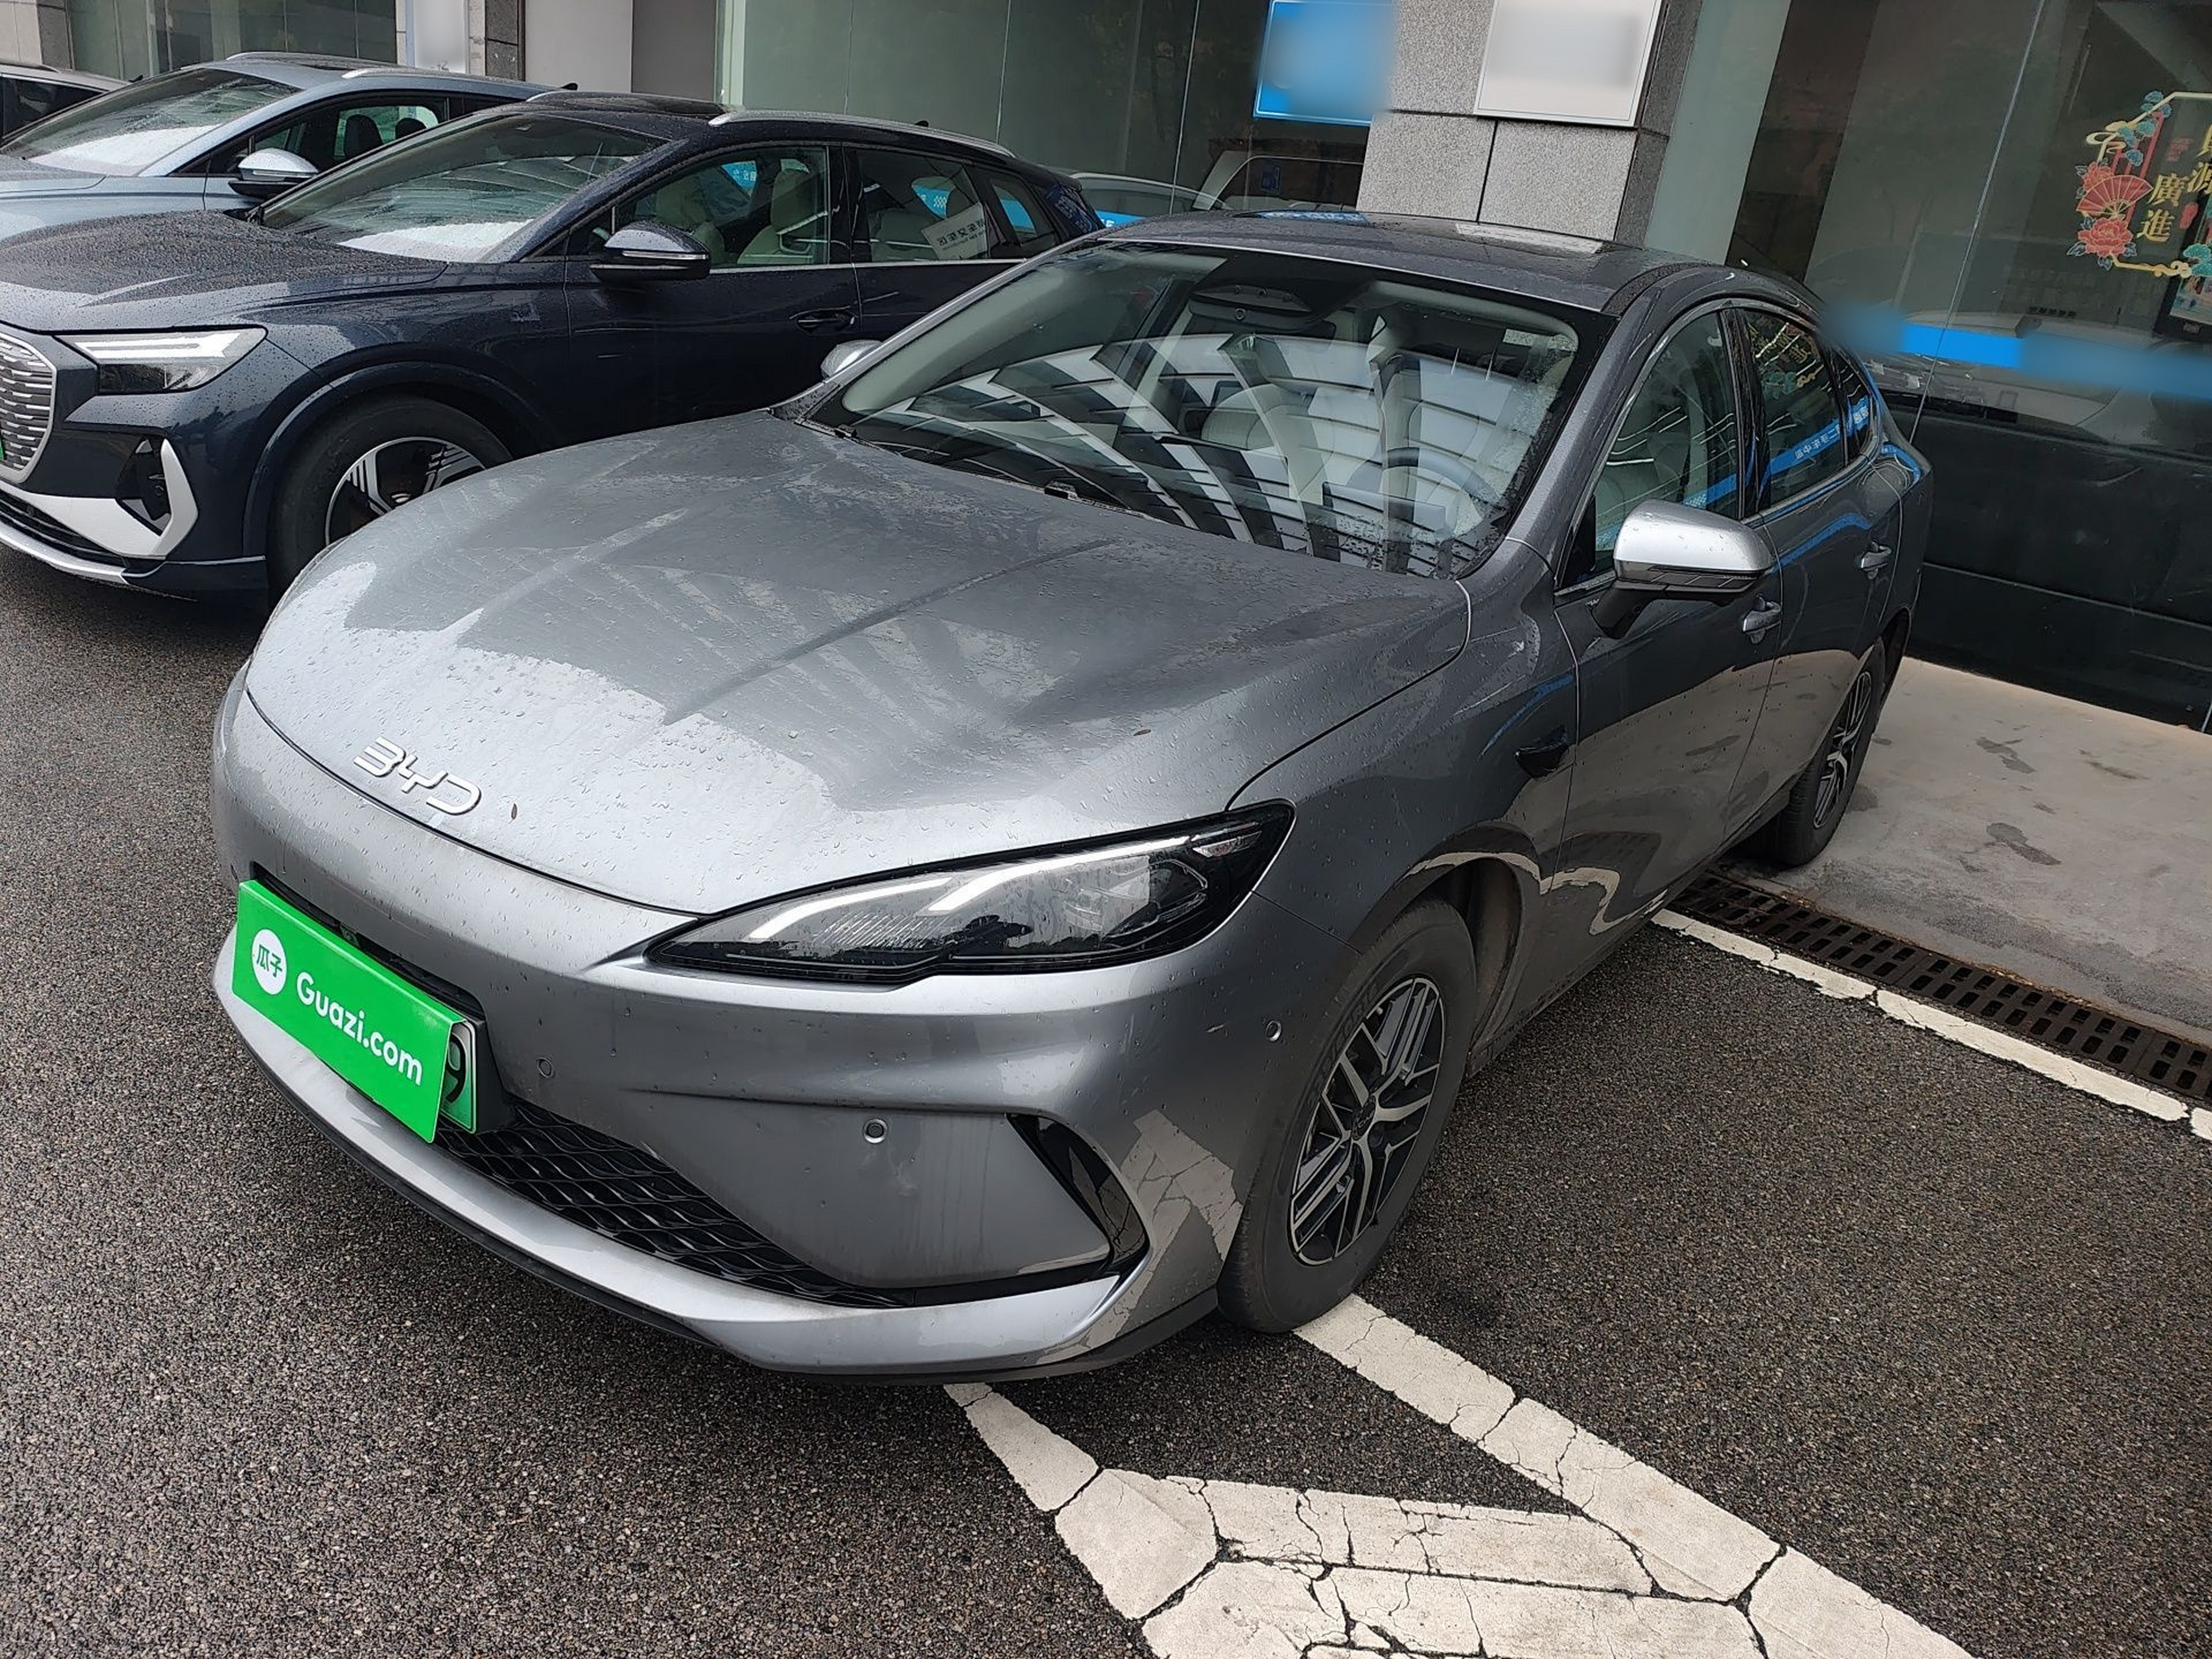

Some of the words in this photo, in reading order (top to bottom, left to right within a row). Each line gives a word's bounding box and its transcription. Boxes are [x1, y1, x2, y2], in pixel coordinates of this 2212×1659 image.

[2137, 173, 2190, 242] 廣進
[353, 737, 482, 816] BYD
[256, 944, 283, 978] 瓜子
[296, 971, 423, 1086] Guazi.com
